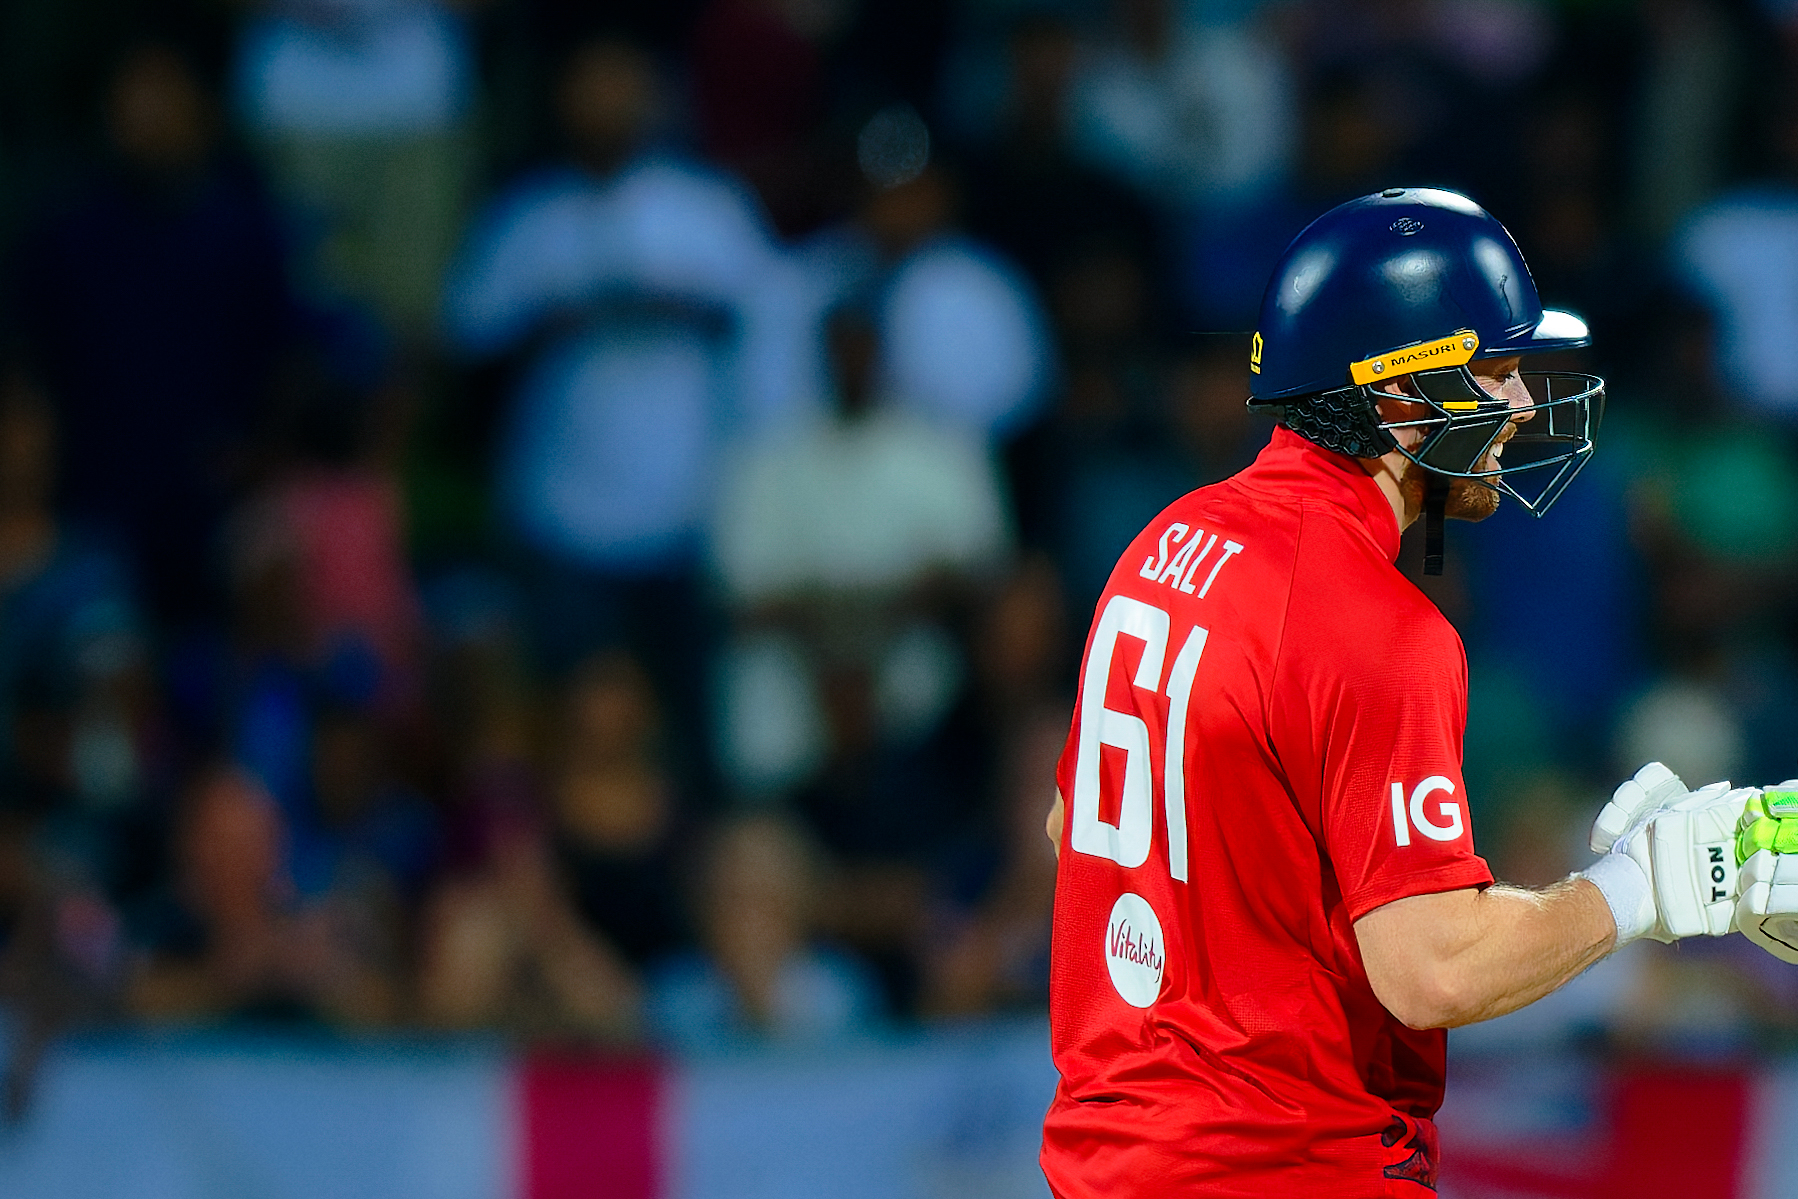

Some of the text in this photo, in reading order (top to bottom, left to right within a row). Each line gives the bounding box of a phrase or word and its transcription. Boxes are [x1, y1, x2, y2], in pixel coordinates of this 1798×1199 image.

[1391, 343, 1456, 366] MASURI
[1139, 521, 1243, 600] SALT
[1071, 594, 1209, 884] 61
[1391, 775, 1464, 847] IG
[1708, 847, 1726, 902] TON
[1111, 918, 1161, 983] Vitality
